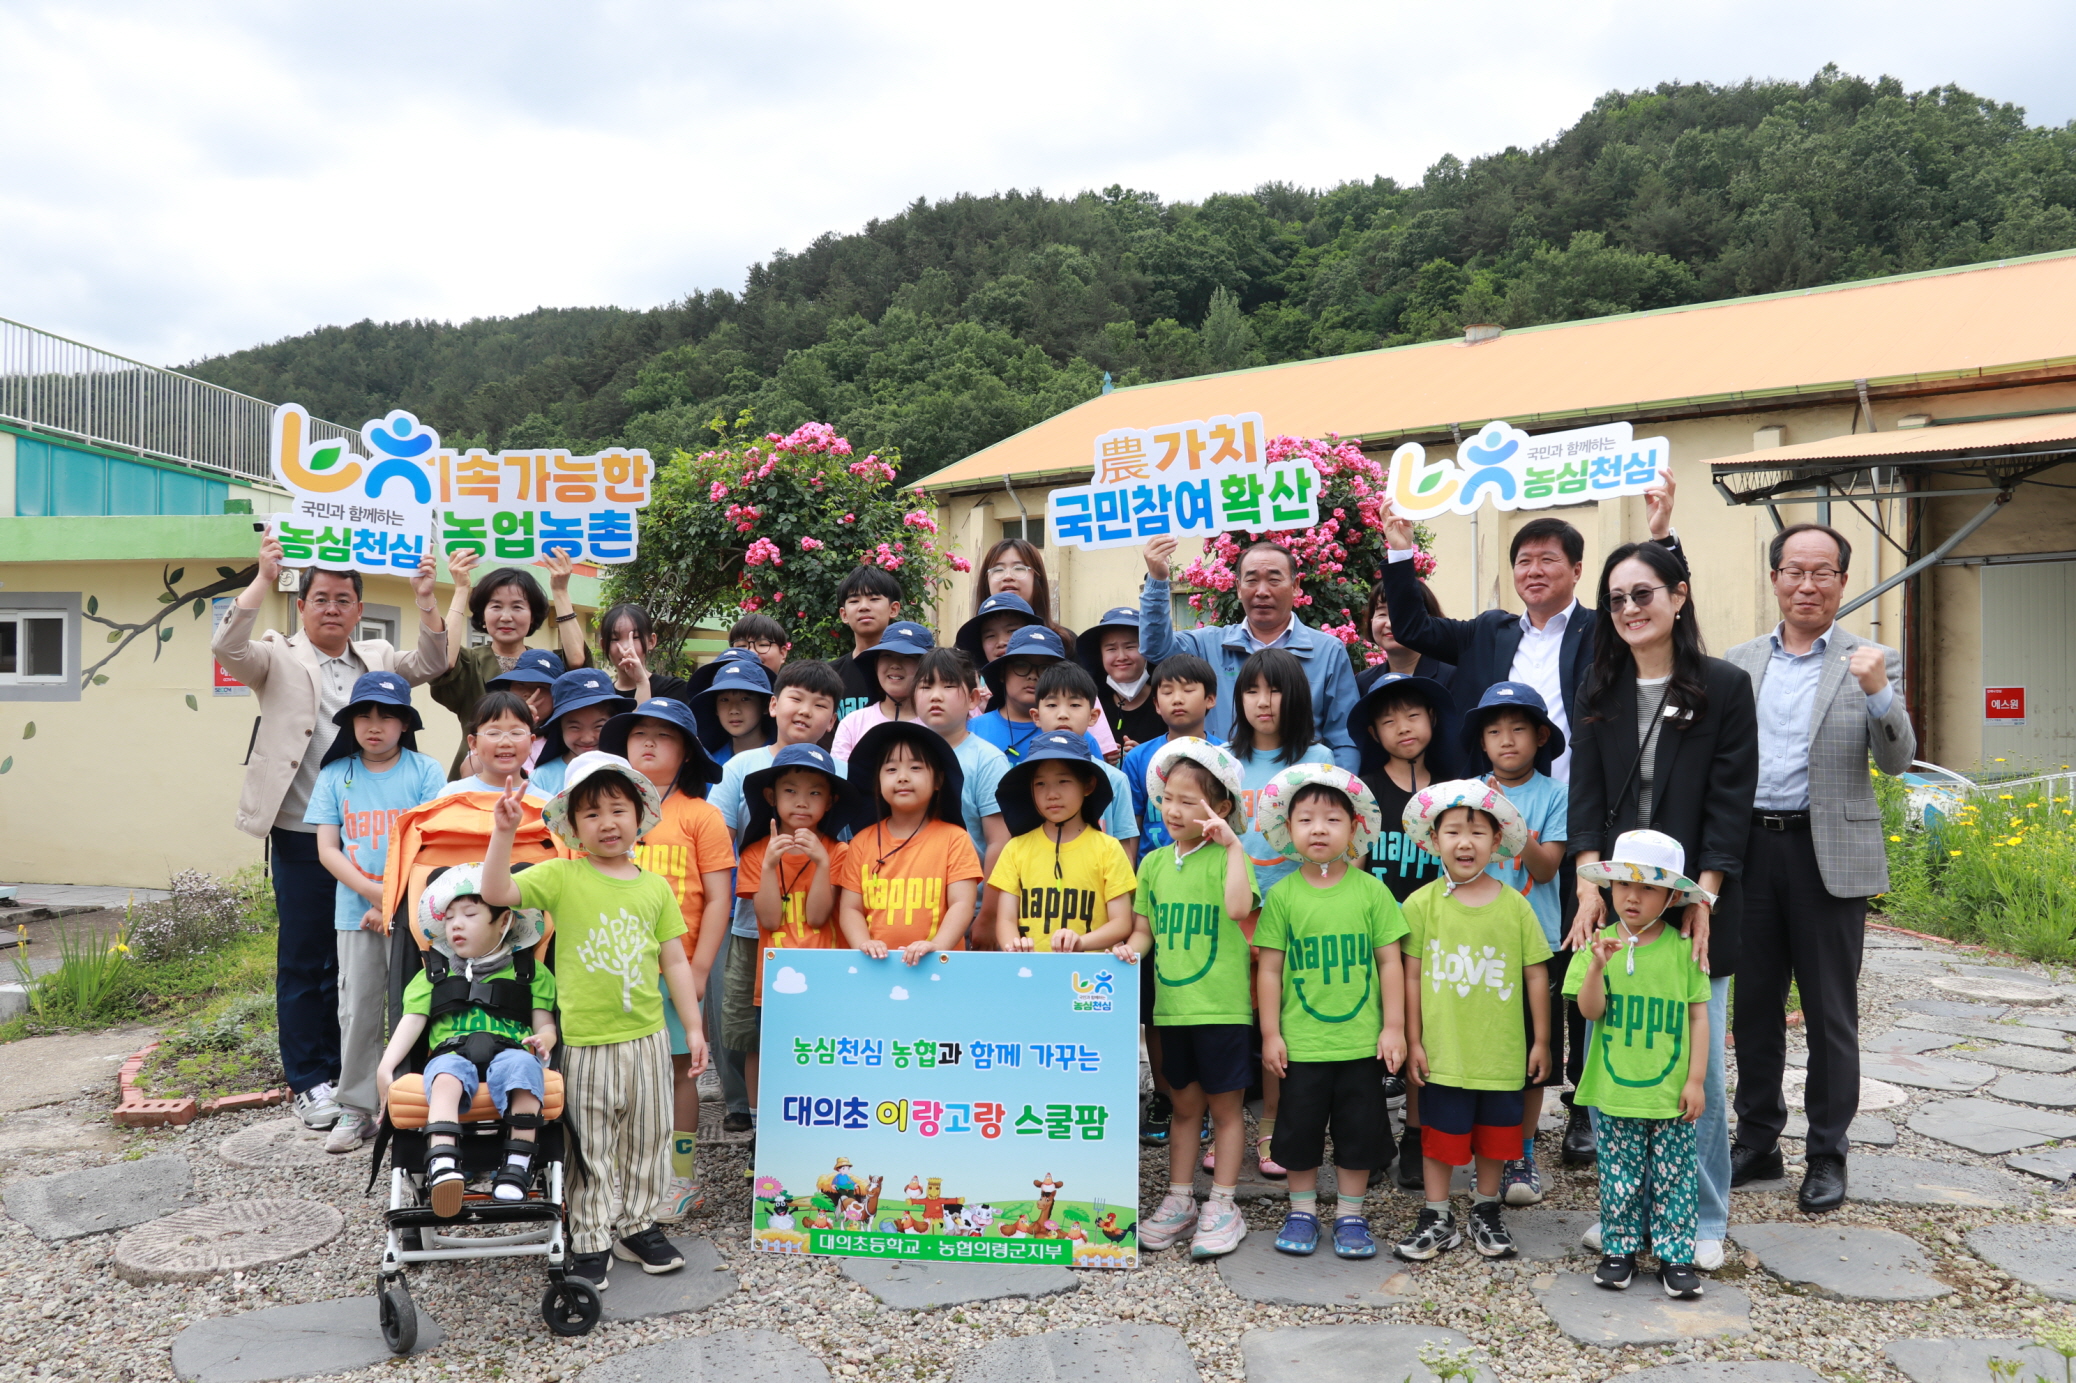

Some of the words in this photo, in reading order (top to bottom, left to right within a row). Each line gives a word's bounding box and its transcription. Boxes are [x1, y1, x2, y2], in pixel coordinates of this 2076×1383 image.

[1527, 443, 1563, 461] 국민과
[1567, 437, 1617, 455] 함께하는
[1524, 449, 1657, 498] 농심천심
[301, 501, 346, 520] 국민과
[348, 505, 405, 527] 함께하는
[1055, 478, 1214, 543] 국민참여
[1220, 467, 1312, 525] 확산
[278, 521, 423, 570] 농심천심
[1991, 699, 2018, 709] 에스원
[576, 914, 650, 963] HAPPY
[1288, 923, 1372, 985] happy
[1431, 952, 1505, 988] LOVE
[1073, 1001, 1111, 1011] 농심천심
[793, 1036, 883, 1066] 농심천심
[891, 1040, 962, 1069] 농협과
[970, 1040, 1021, 1069] 함께
[1030, 1043, 1101, 1072] 가꾸는
[783, 1096, 869, 1129] 대의초
[876, 1098, 1006, 1139] 이랑고랑
[1014, 1103, 1109, 1141] 스쿨팜
[676, 1139, 692, 1154] C
[819, 1234, 920, 1254] 대의초등학교
[938, 1240, 1063, 1260] 농협의령군지부
